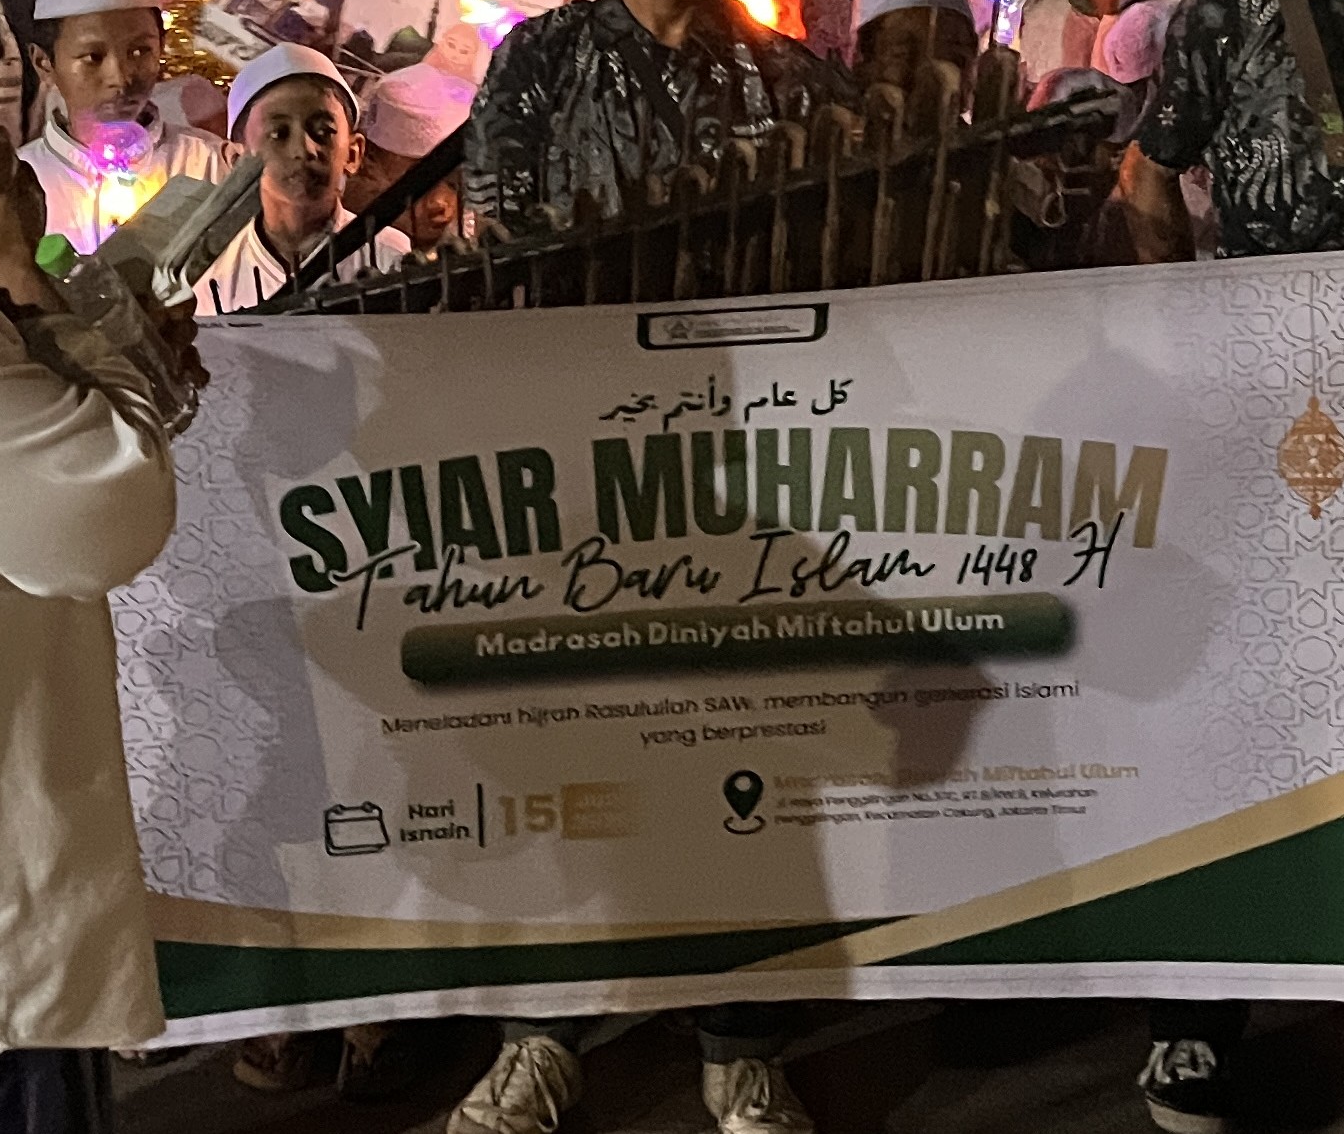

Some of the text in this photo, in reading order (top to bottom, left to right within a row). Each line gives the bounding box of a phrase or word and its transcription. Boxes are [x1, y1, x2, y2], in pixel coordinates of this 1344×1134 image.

[744, 382, 797, 424] عام
[811, 379, 853, 415] كل
[279, 428, 1168, 593] SYIAR MUHARRAM
[330, 511, 1125, 630] Tahun Baru Islam 1448 H
[474, 607, 1005, 657] Madrasah Diniyah Miftahul Ulum
[380, 712, 512, 735] Meneladani
[517, 705, 581, 728] hijrah
[584, 697, 699, 721] Rasulullah
[762, 687, 907, 713] membangun
[913, 681, 1010, 708] generasi
[1014, 678, 1081, 700] Islami
[639, 719, 827, 749] yang berprestasi
[1079, 762, 1140, 780] Ulum
[407, 799, 455, 821] Hari
[498, 793, 557, 837] 15
[399, 822, 471, 843] Isnain
